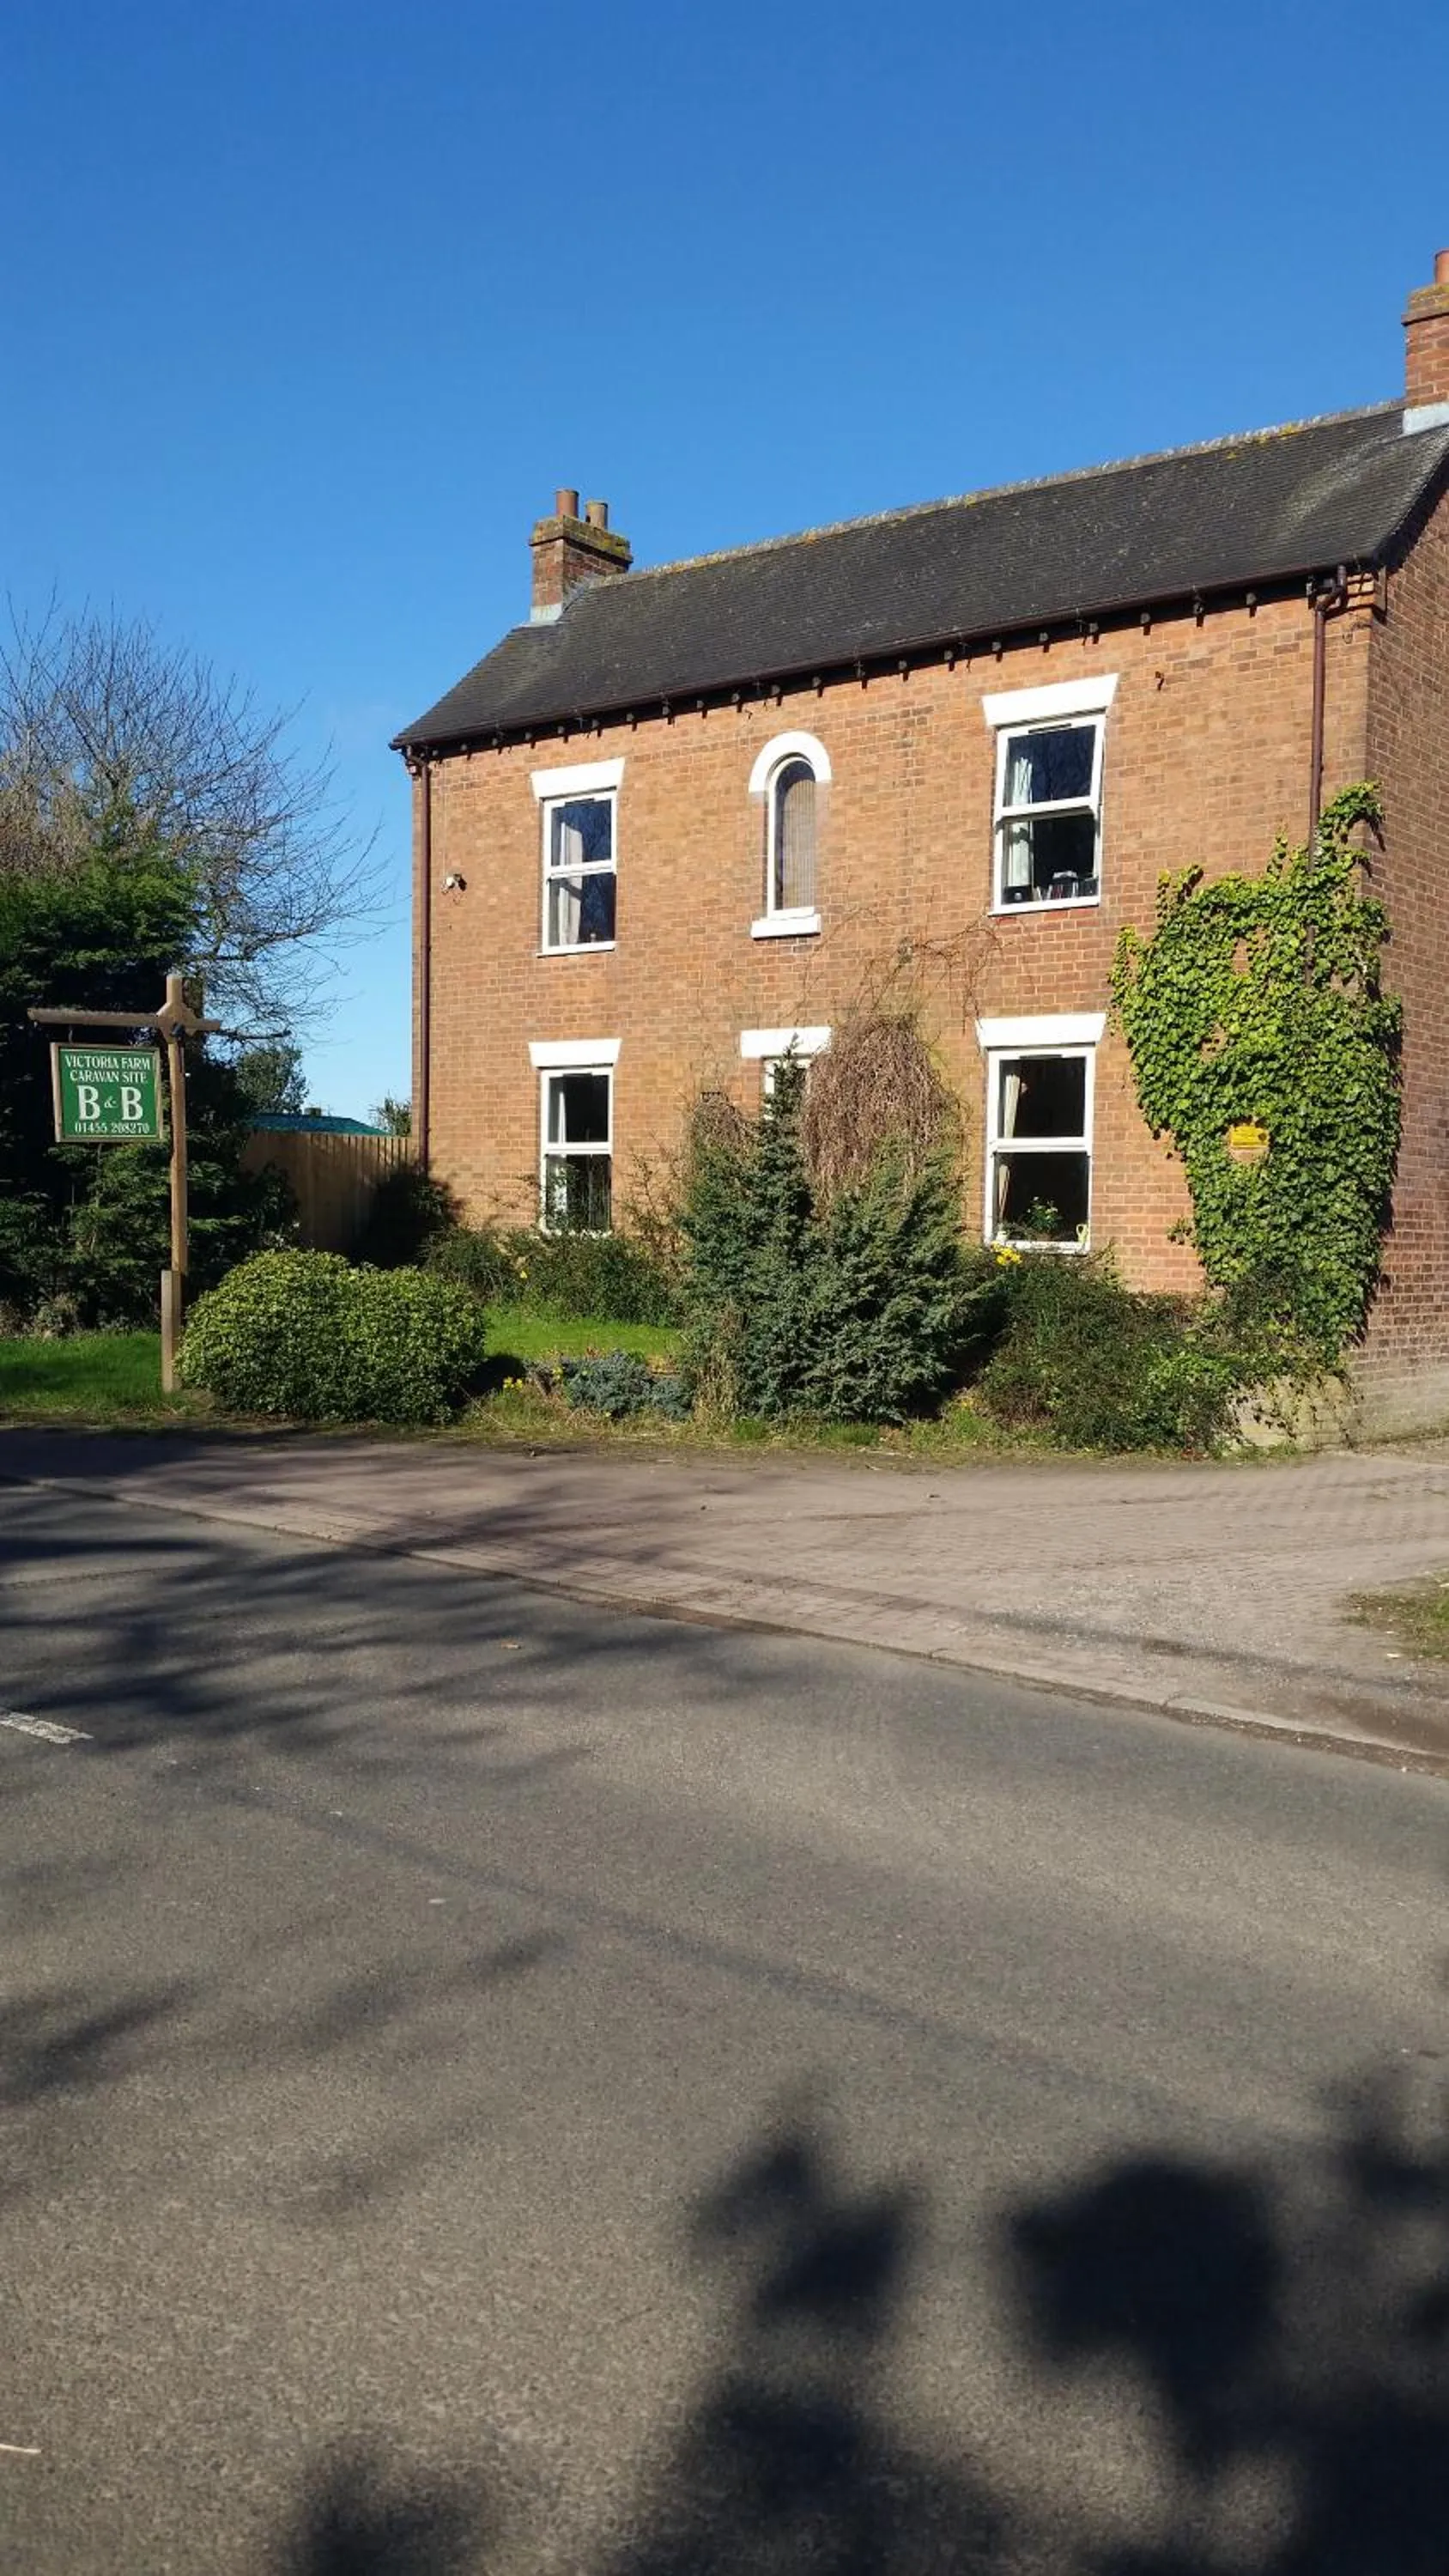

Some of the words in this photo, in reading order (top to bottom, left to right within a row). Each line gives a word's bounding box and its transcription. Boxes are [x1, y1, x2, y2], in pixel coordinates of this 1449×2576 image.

[64, 1055, 119, 1069] VICTORIA
[121, 1057, 150, 1070] FARM
[70, 1070, 119, 1083] CARAVAN
[122, 1072, 148, 1084] SITE
[77, 1084, 100, 1120] B
[104, 1096, 118, 1109] &
[121, 1086, 143, 1121] B
